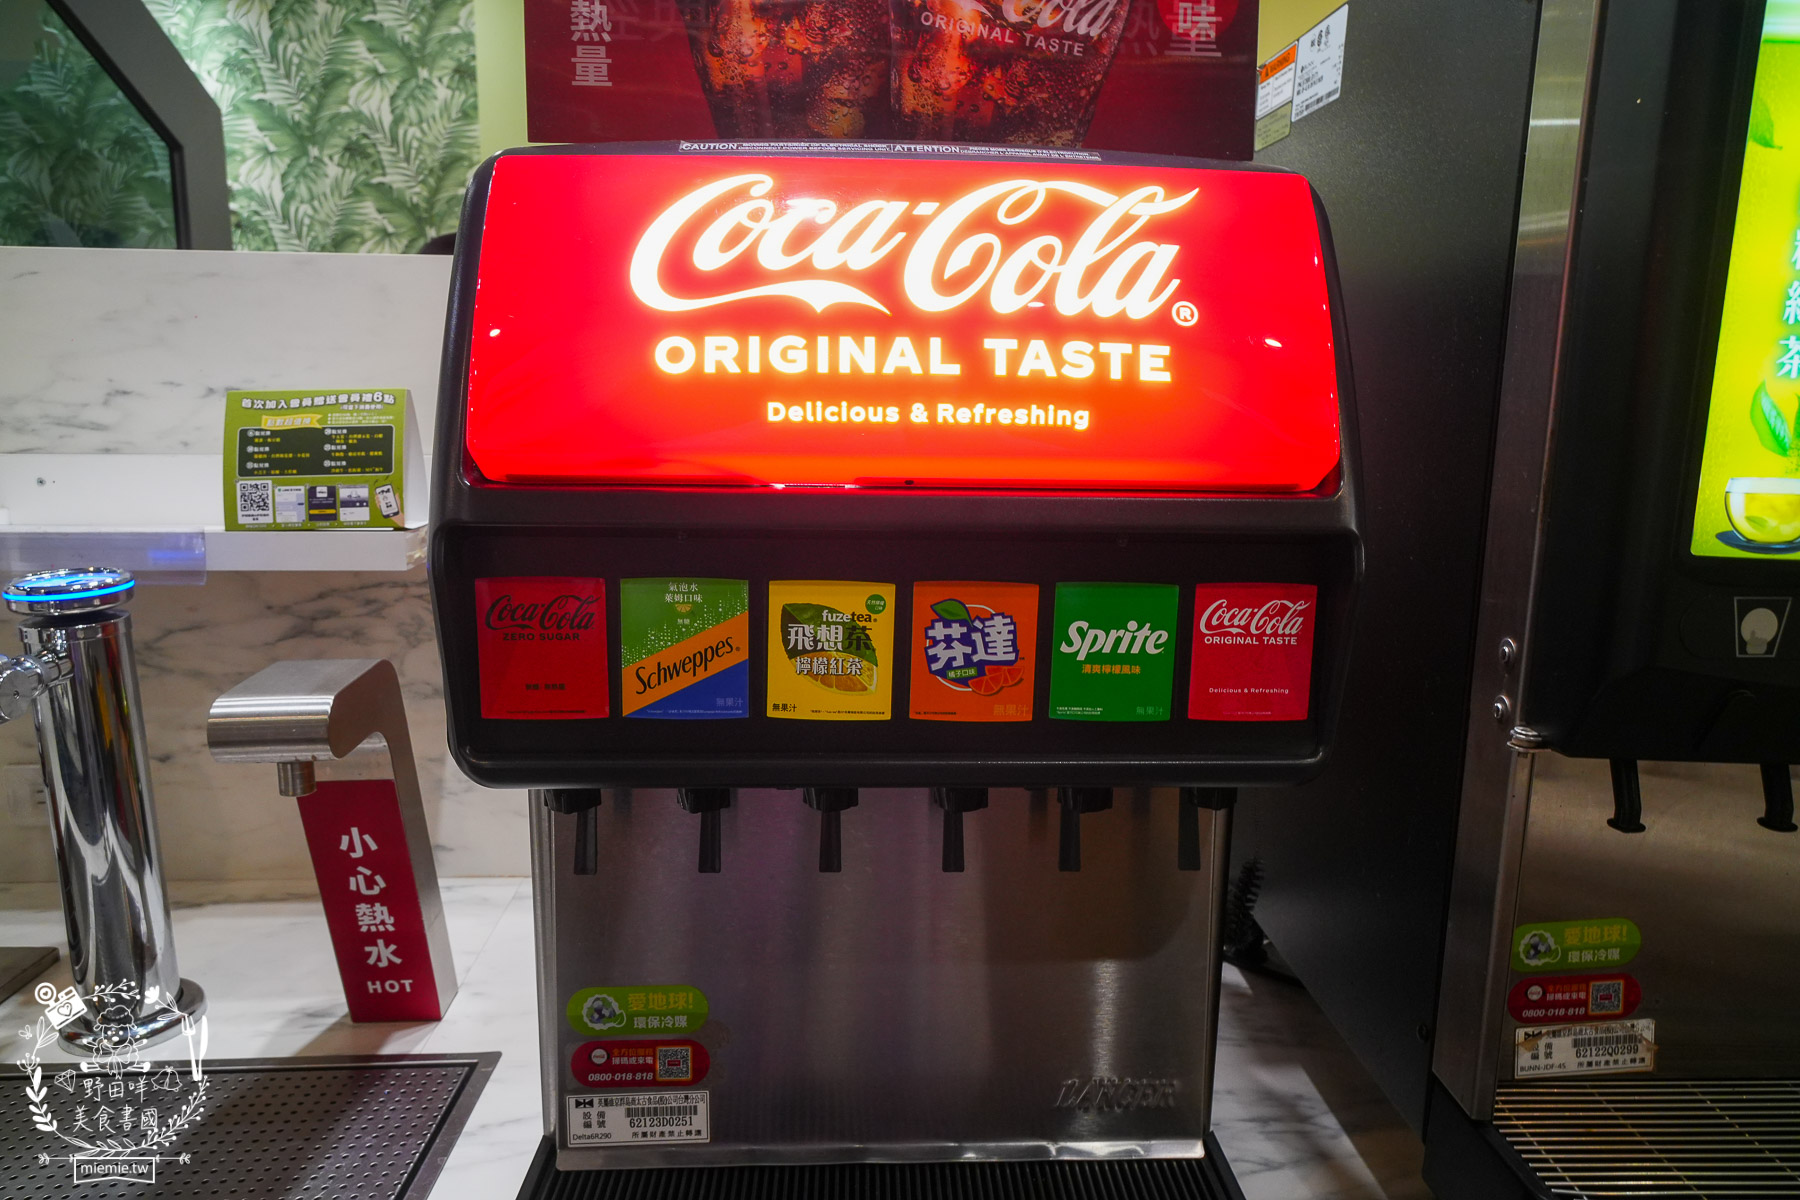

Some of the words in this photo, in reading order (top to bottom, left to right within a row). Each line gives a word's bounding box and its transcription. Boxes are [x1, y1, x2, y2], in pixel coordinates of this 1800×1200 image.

[920, 11, 1015, 44] ORIGINAL
[1025, 33, 1085, 57] TASTE
[682, 143, 738, 151] CAUTION
[894, 145, 960, 153] ATTENTION
[630, 173, 1199, 319] Coca-Cola
[654, 335, 961, 375] ORIGINAL
[983, 338, 1172, 382] TASTE
[767, 401, 900, 423] Delicious
[910, 403, 929, 423] &
[937, 403, 1090, 430] Refreshing
[668, 581, 699, 593] 氣泡水
[665, 593, 703, 604] 萊姆口味
[485, 594, 602, 630] Coca-Cola
[821, 609, 872, 623] fuzetea
[1200, 599, 1311, 635] Coca-Cola
[503, 633, 536, 641] ZERO
[539, 632, 580, 641] SUGAR
[787, 623, 873, 651] 飛想茶
[927, 615, 1017, 672] 芬達
[1060, 620, 1169, 661] Sprite
[1204, 636, 1259, 645] ORIGINAL
[1263, 636, 1297, 645] TASTE
[635, 636, 734, 695] Schweppes
[795, 656, 864, 676] 檸檬紅茶
[1081, 663, 1141, 675] 清爽檸檬風味
[715, 697, 744, 708] 無果汁
[772, 703, 797, 713] 無果汁
[993, 704, 1029, 716] 無果汁
[1136, 705, 1165, 716] 無果汁
[339, 827, 403, 969] 小心熱水
[1564, 924, 1627, 946] 愛地球!
[367, 979, 413, 994] HOT
[628, 992, 694, 1011] 愛地球!
[1522, 1007, 1585, 1017] 0800-018-818
[633, 1015, 688, 1029] 環保冷媒
[1575, 1044, 1639, 1059] 62122Q0299
[588, 1072, 654, 1081] 0800-018-818
[629, 1116, 693, 1128] 62123D0251
[572, 1132, 612, 1141] Delta6R290
